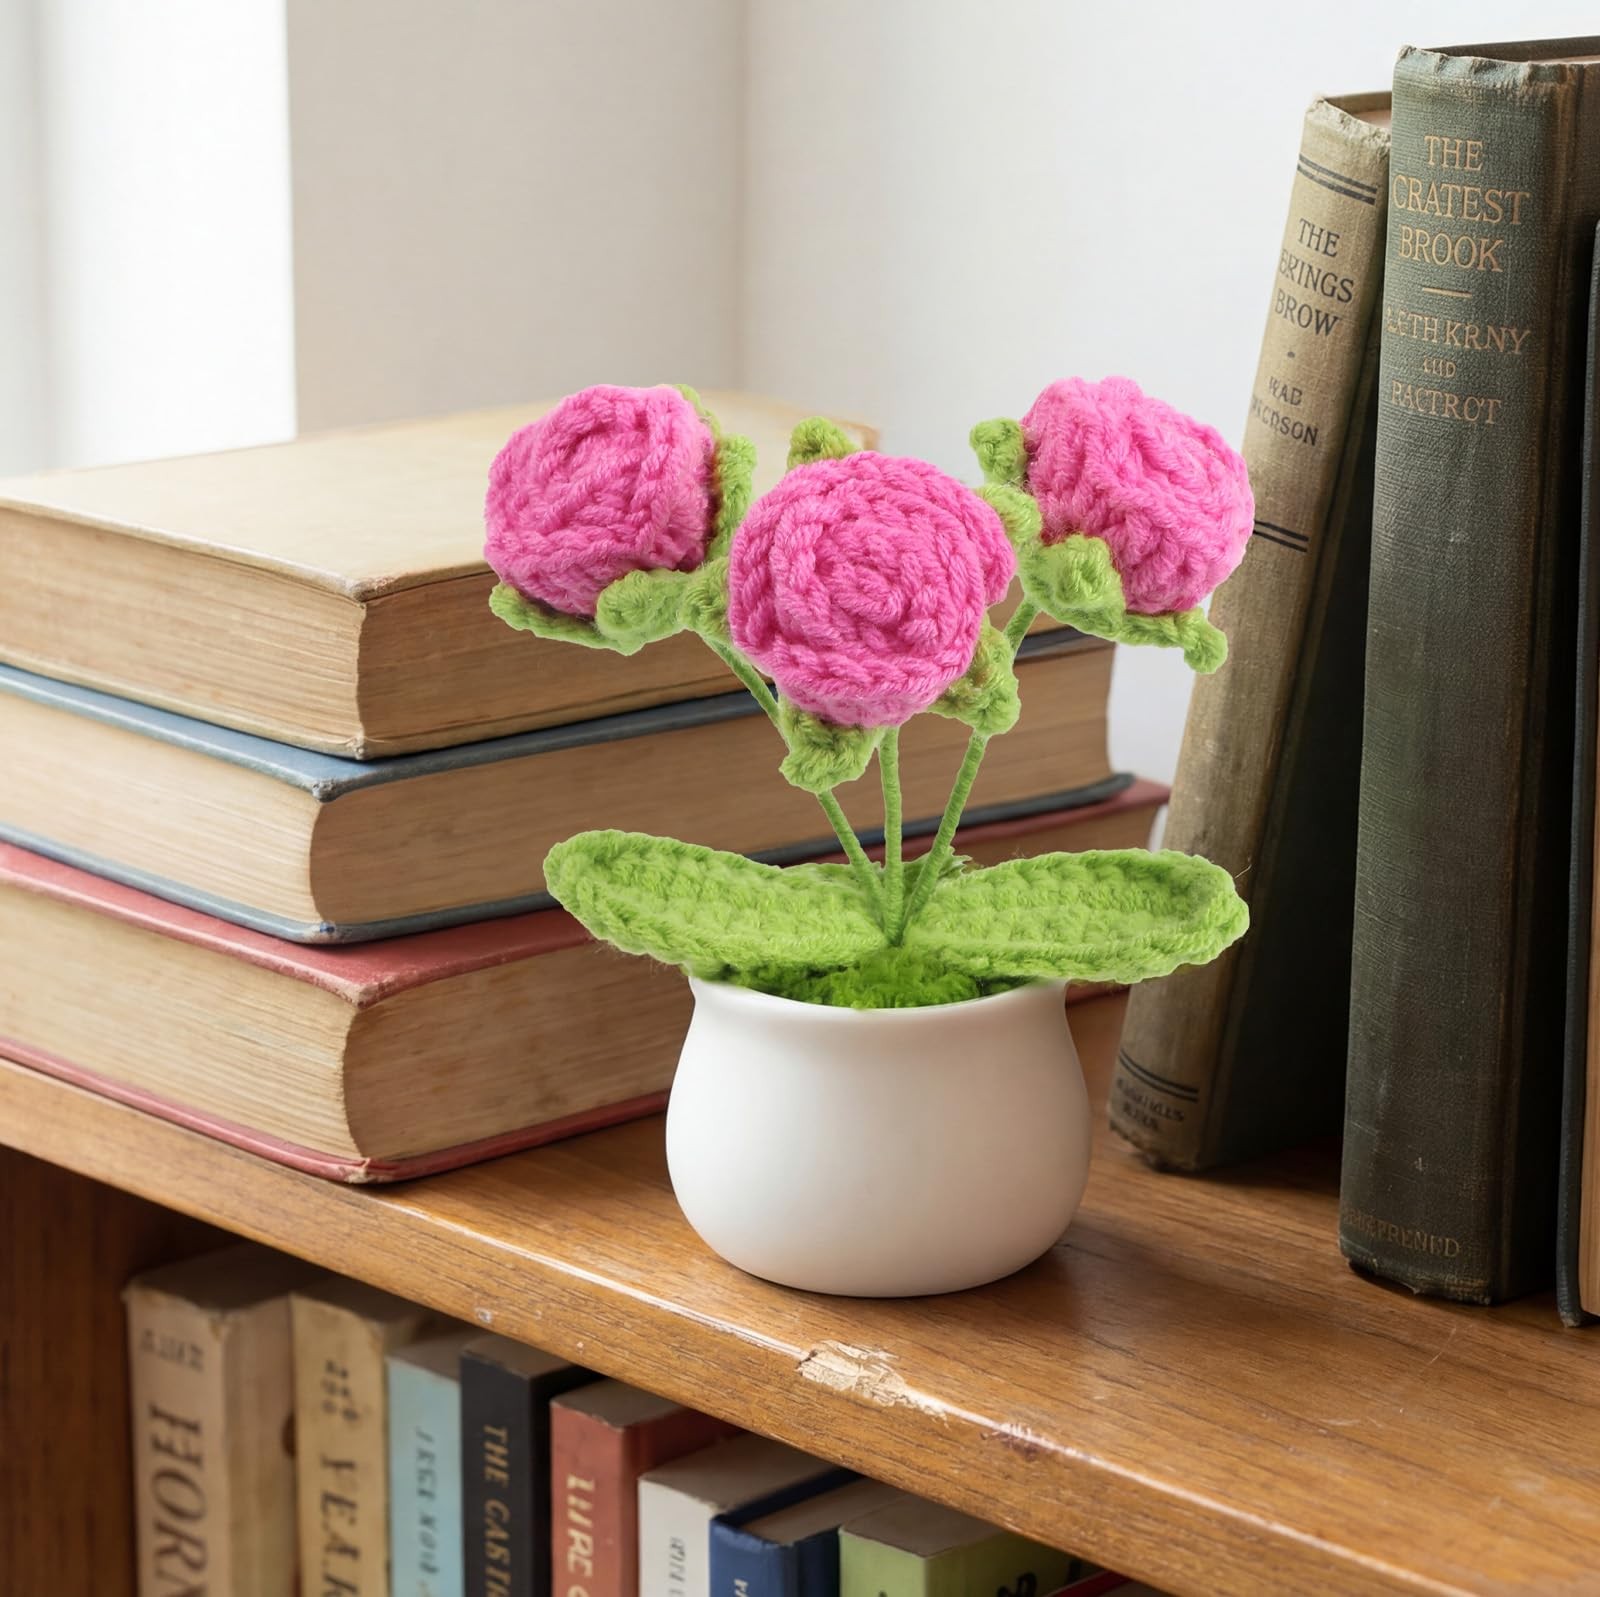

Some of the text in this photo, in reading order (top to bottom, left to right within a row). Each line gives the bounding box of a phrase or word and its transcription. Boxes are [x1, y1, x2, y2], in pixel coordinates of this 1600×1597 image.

[1424, 135, 1484, 172] THE
[1391, 174, 1531, 225] CRATEST
[1297, 218, 1341, 258] THE
[1399, 223, 1505, 273] BROOK
[1274, 289, 1343, 337] BROW
[482, 1424, 509, 1488] THE
